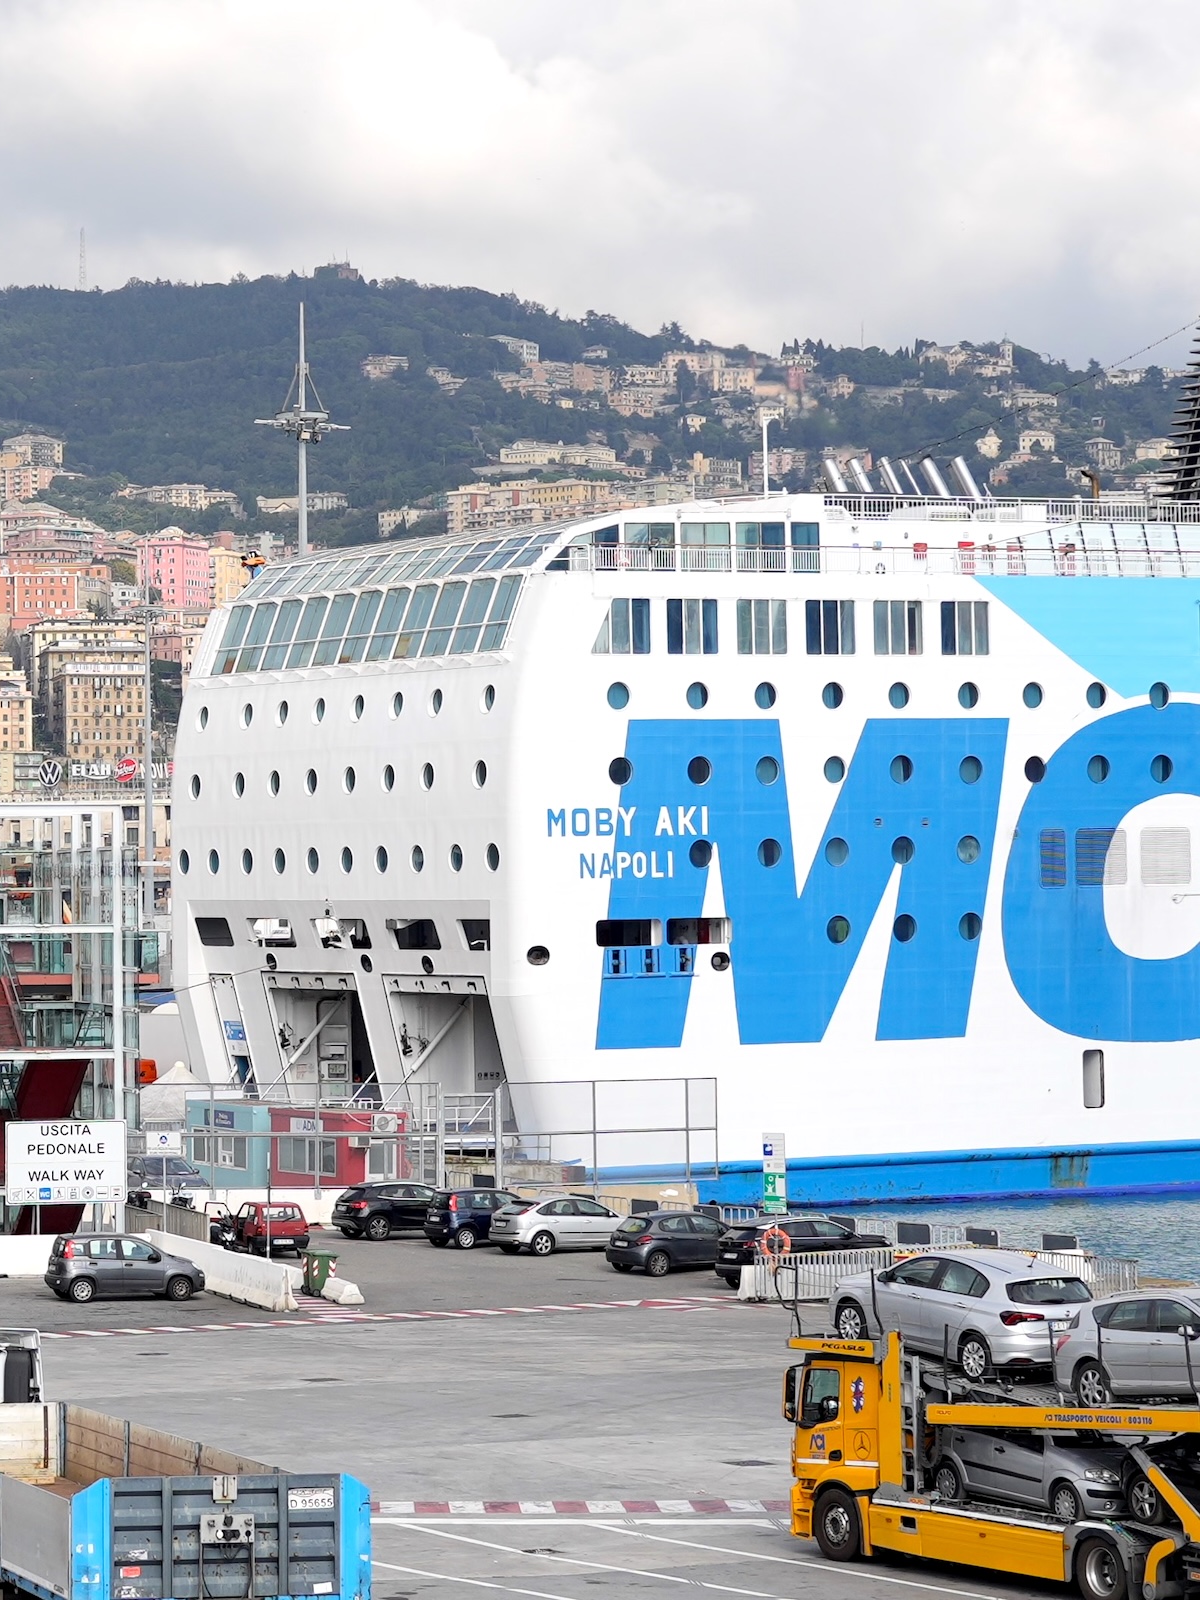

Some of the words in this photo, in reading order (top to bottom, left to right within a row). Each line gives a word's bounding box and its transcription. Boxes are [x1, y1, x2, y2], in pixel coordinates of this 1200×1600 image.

[72, 763, 111, 778] ELAH
[547, 807, 637, 837] MOBY
[655, 806, 709, 836] AKI
[579, 851, 674, 879] NAPOLI
[40, 1124, 91, 1136] USCITA
[27, 1143, 105, 1155] PEDONALE
[28, 1170, 69, 1182] WALK
[74, 1169, 105, 1181] WAY
[821, 1342, 865, 1352] PEGASUS
[1054, 1414, 1093, 1423] TRASPORTO
[1095, 1415, 1122, 1424] VEICOLI
[290, 1499, 298, 1509] D
[301, 1498, 333, 1508] 95655
